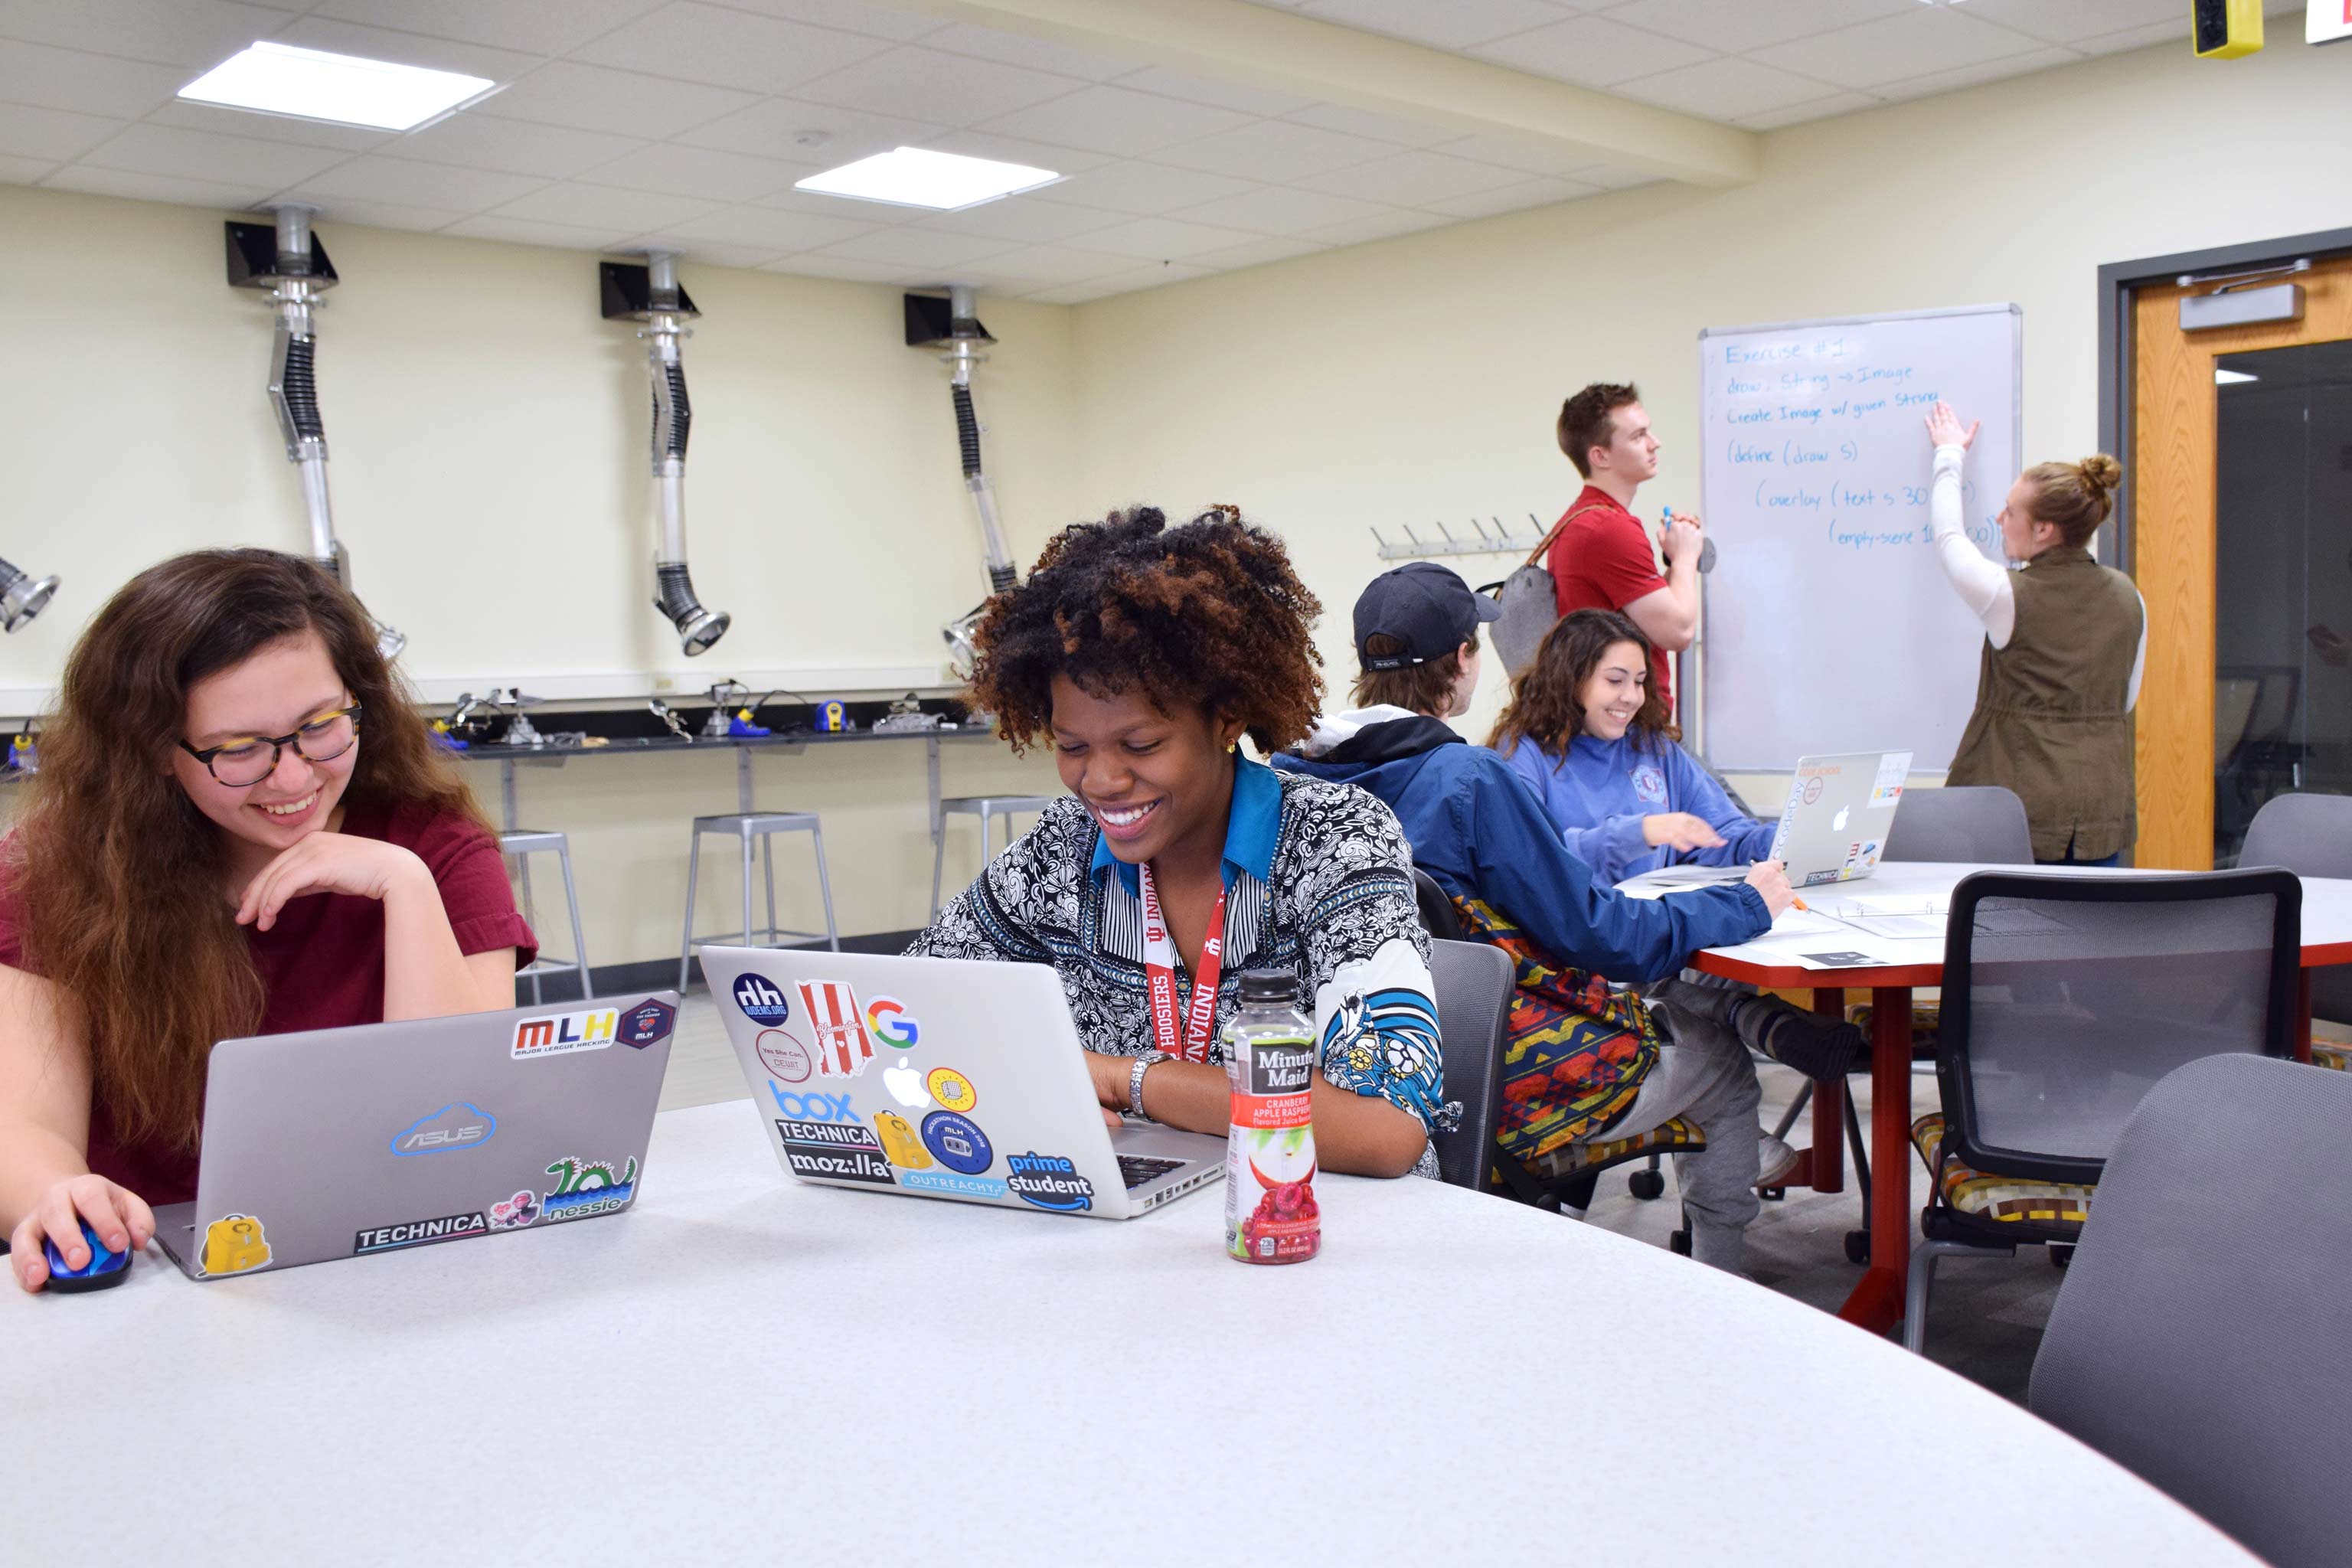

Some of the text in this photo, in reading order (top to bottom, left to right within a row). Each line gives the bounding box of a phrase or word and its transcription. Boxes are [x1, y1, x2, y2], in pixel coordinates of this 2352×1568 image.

[1726, 345, 1801, 364] Exercise
[1780, 372, 1830, 391] String
[1857, 367, 1912, 386] Image
[1727, 407, 1772, 424] Create
[1779, 405, 1822, 425] Image
[1853, 399, 1886, 419] given
[745, 1004, 787, 1016] IUDEMS.ORG
[1153, 975, 1175, 1047] HOOSIERS
[516, 1011, 616, 1049] MLH
[635, 1031, 654, 1040] MLH
[816, 1020, 863, 1040] Bloomington
[514, 1039, 611, 1057] MAJOR LEAGUE HACKING
[1258, 1050, 1314, 1069] Minute
[1267, 1066, 1309, 1086] Maid
[769, 1080, 861, 1123] box
[1266, 1096, 1308, 1109] CRANBERRY
[1253, 1108, 1280, 1118] APPLE
[1253, 1117, 1281, 1125] Flavored
[404, 1125, 484, 1148] ASUS
[778, 1122, 877, 1145] TECHNICA
[927, 1116, 986, 1148] HACKATHON SEASON 2018
[944, 1126, 964, 1135] MLH
[789, 1152, 890, 1178] moz:lla
[1009, 1153, 1073, 1174] prime
[910, 1174, 993, 1194] OUTREACHY
[1009, 1175, 1092, 1195] student
[549, 1197, 623, 1220] nessie
[360, 1214, 485, 1247] TECHNICA
